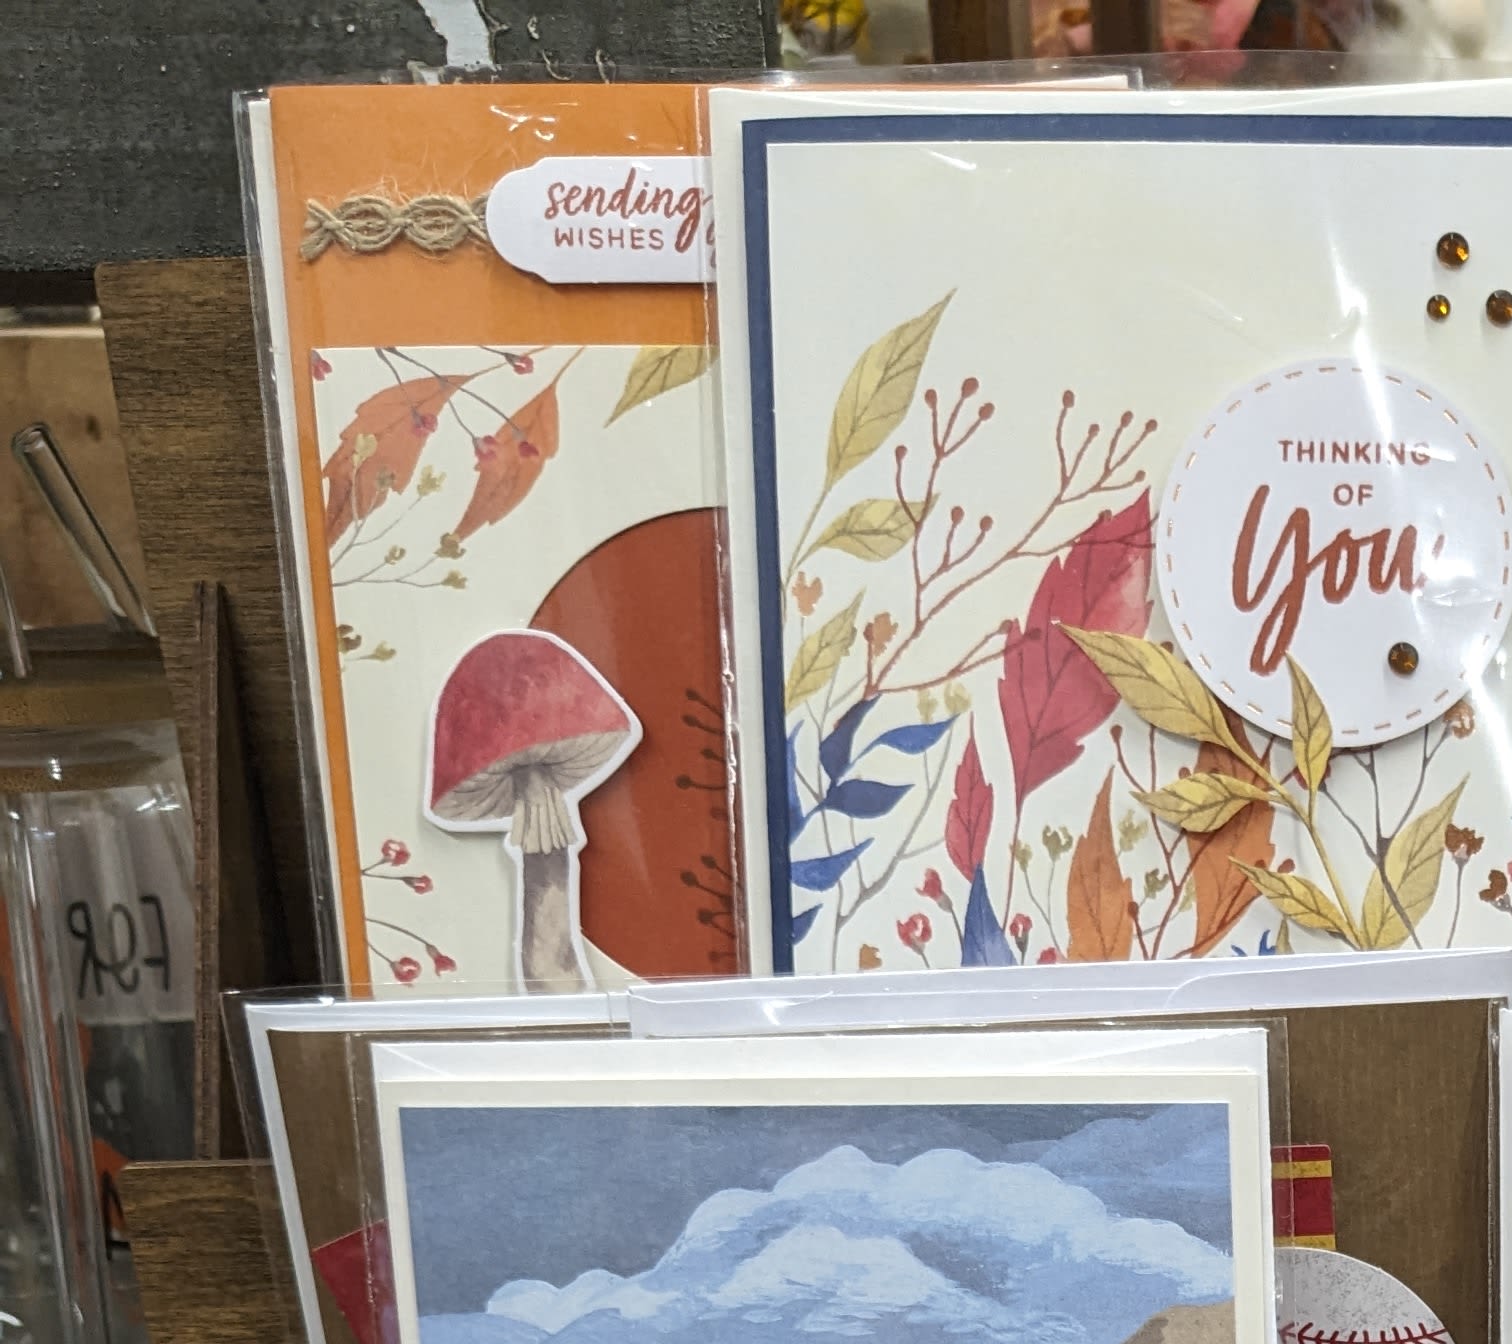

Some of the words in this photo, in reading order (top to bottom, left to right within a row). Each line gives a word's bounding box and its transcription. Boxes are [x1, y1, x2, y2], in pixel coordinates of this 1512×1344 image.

[544, 167, 706, 253] sending
[554, 227, 664, 250] WISHES
[1278, 439, 1431, 466] THINKING
[1333, 483, 1374, 506] OF
